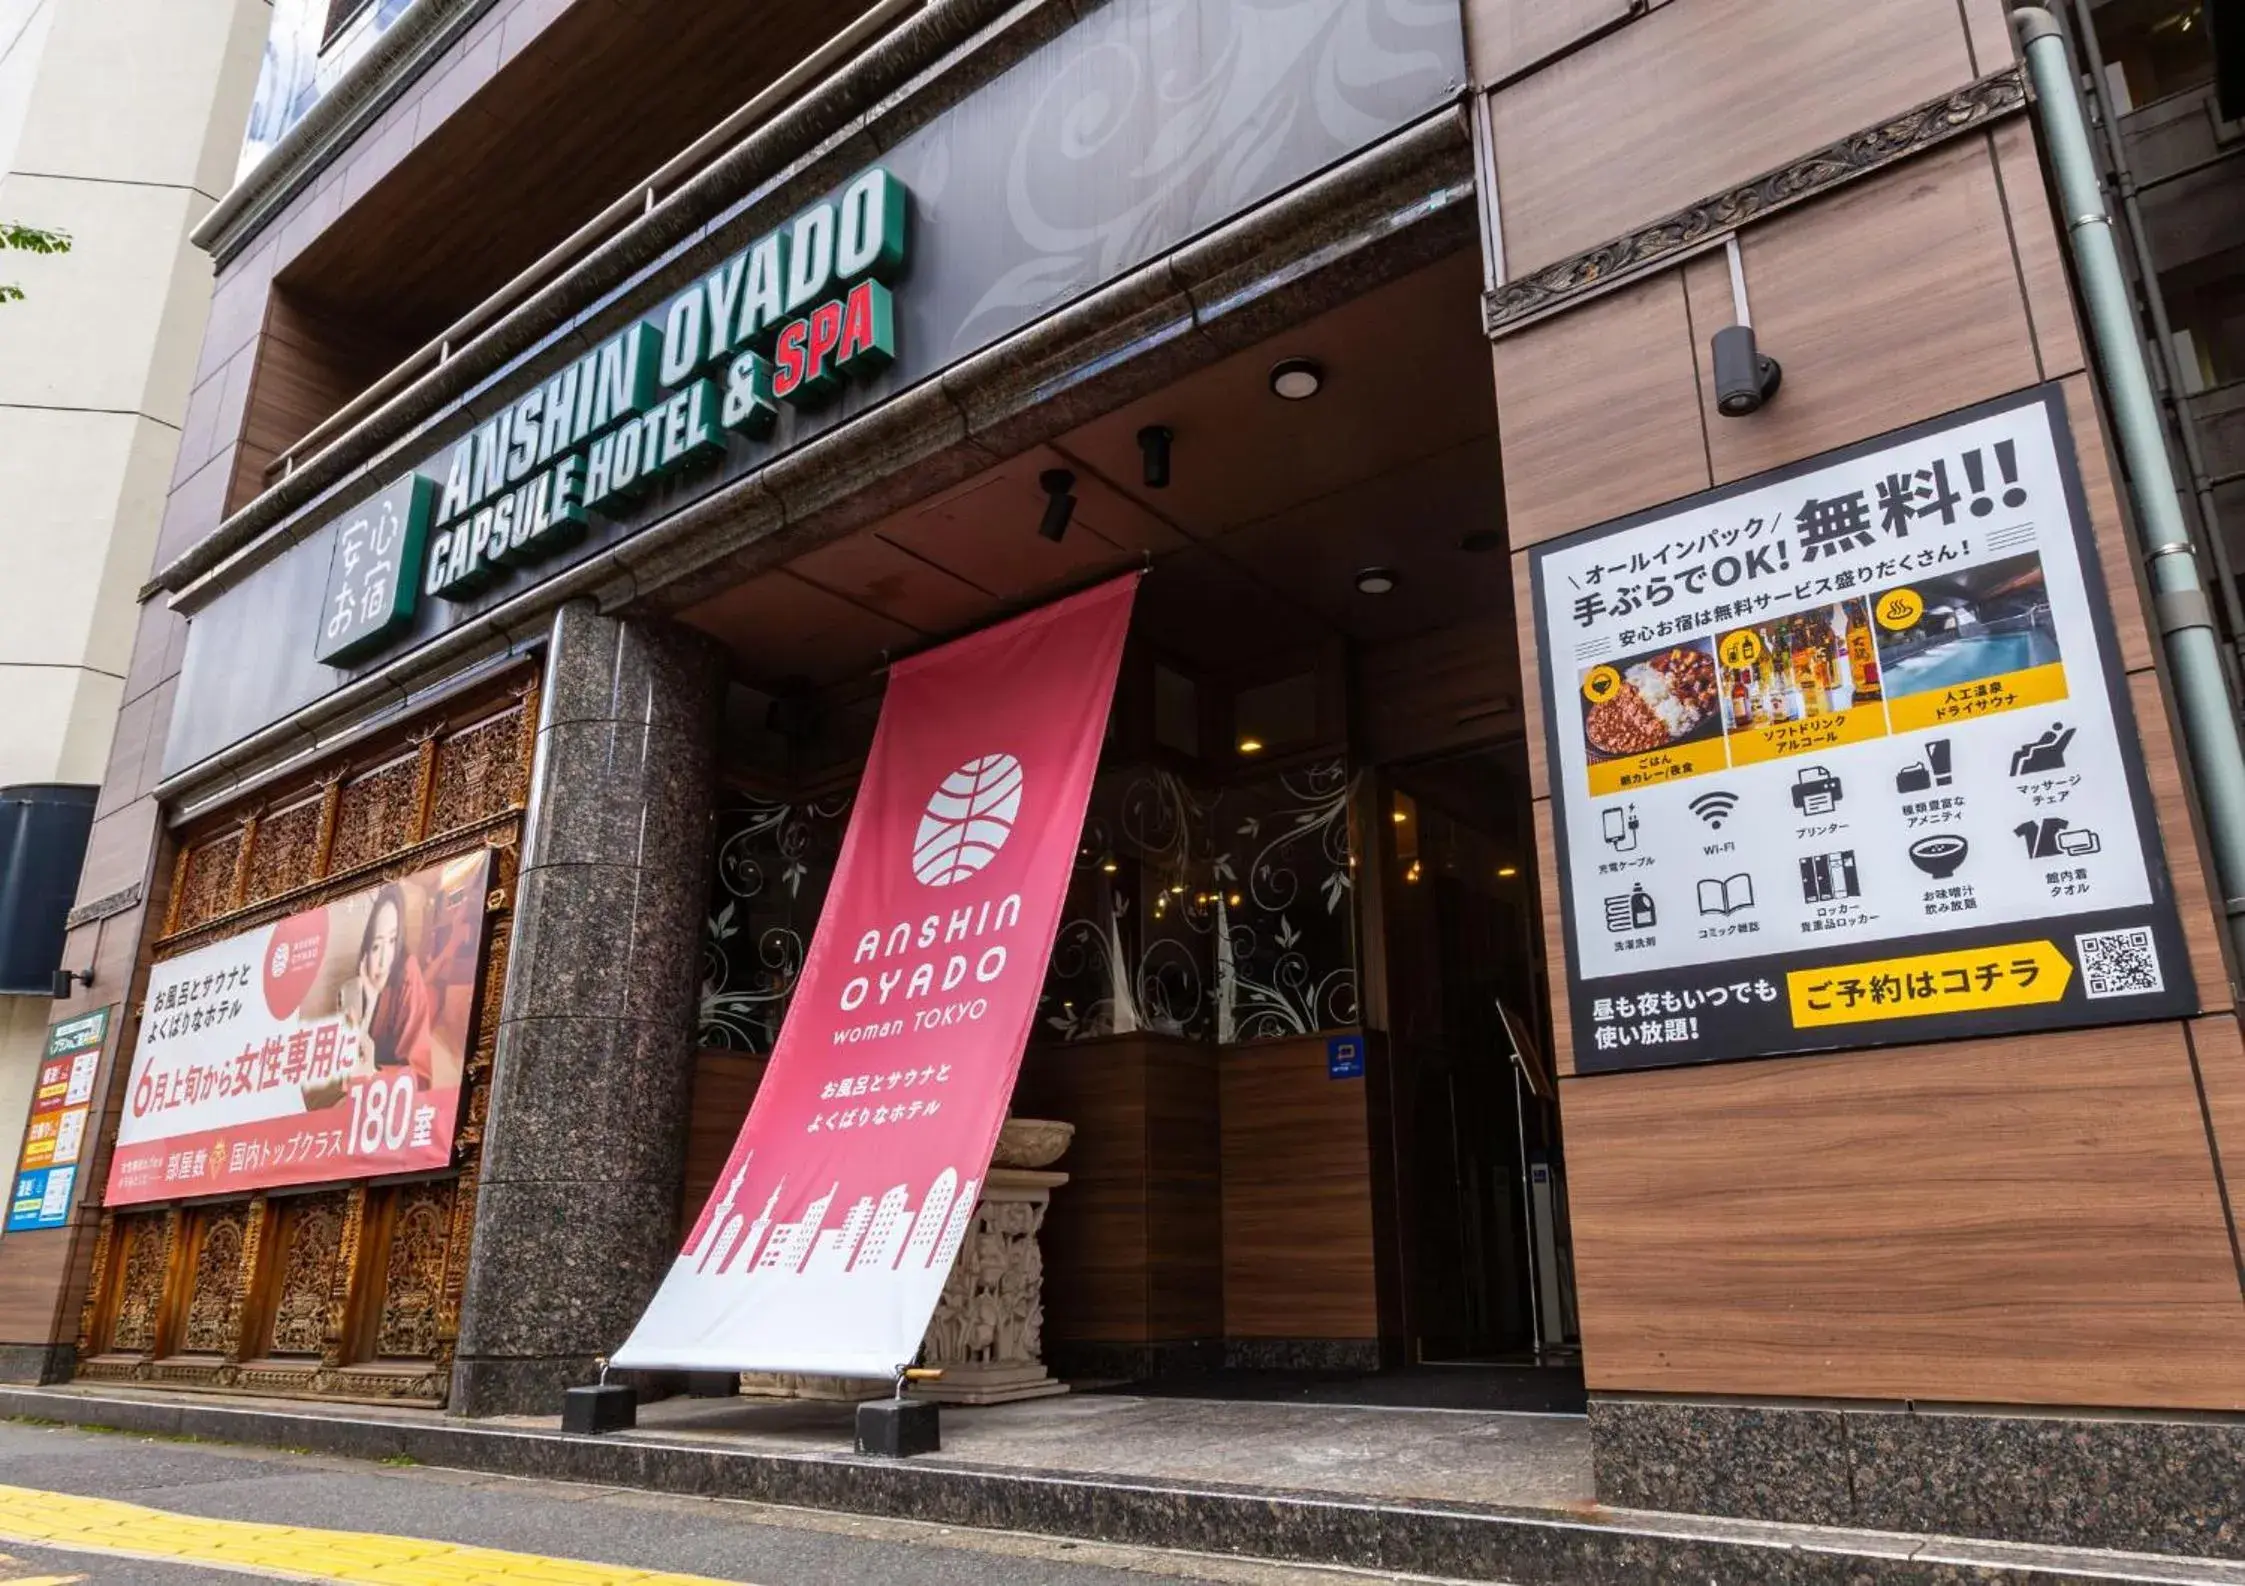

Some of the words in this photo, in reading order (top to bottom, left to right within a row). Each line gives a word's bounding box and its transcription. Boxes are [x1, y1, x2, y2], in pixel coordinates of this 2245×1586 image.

[435, 321, 643, 527] ANSHIN
[659, 168, 885, 388] OYADO
[425, 455, 576, 596] CAPSULE
[582, 378, 708, 507] HOTEL
[721, 350, 758, 428] &
[772, 278, 873, 398] SPA
[1794, 438, 2027, 563] 無料!!
[342, 500, 399, 577] 安心
[1586, 517, 1764, 585] オールインパック
[328, 560, 392, 639] お宿
[1573, 540, 1790, 628] 手ぶらでOK!
[1619, 540, 1971, 648] 安心お宿は無料サービス盛りだくさん!
[1935, 693, 2018, 720] ドライサウナ
[1945, 681, 2003, 704] 人工温泉
[1764, 715, 1845, 742] ソフトドリンク
[1776, 732, 1837, 753] アルコール
[1639, 754, 1671, 769] ごはん
[2016, 774, 2081, 795] マッサージ
[2033, 790, 2069, 806] チェア
[1902, 796, 1965, 816] 種類豊富な
[1907, 811, 1962, 829] アメニティ
[1703, 841, 1736, 855] Wi-Fi
[1796, 823, 1849, 839] プリンター
[1923, 884, 1975, 902] お味噌汁
[2046, 868, 2087, 885] 館内着
[2051, 883, 2089, 898] タオル
[1817, 903, 1860, 917] ロッカー
[1925, 897, 1977, 915] 飲み放題
[854, 894, 1021, 964] ANSHIN
[1801, 914, 1880, 933] 貴重品ロッカー
[153, 963, 252, 1013] お風呂とサウナと
[840, 946, 1007, 1012] OYADO
[1807, 959, 2040, 1012] ご予約はコチラ
[1593, 979, 1778, 1022] 昼も夜もいつでも
[147, 998, 243, 1044] よくばりなホテル
[833, 1018, 903, 1046] woman
[914, 998, 988, 1032] TOKYO
[1595, 1017, 1700, 1050] 使い放題!
[133, 1022, 357, 1119] 6月上旬から女性専用に
[820, 1063, 952, 1100] お風呂とサウナと
[807, 1099, 941, 1133] よくばりなホテル
[165, 1148, 208, 1182] 部屋数
[229, 1129, 343, 1173] 国内トップクラス
